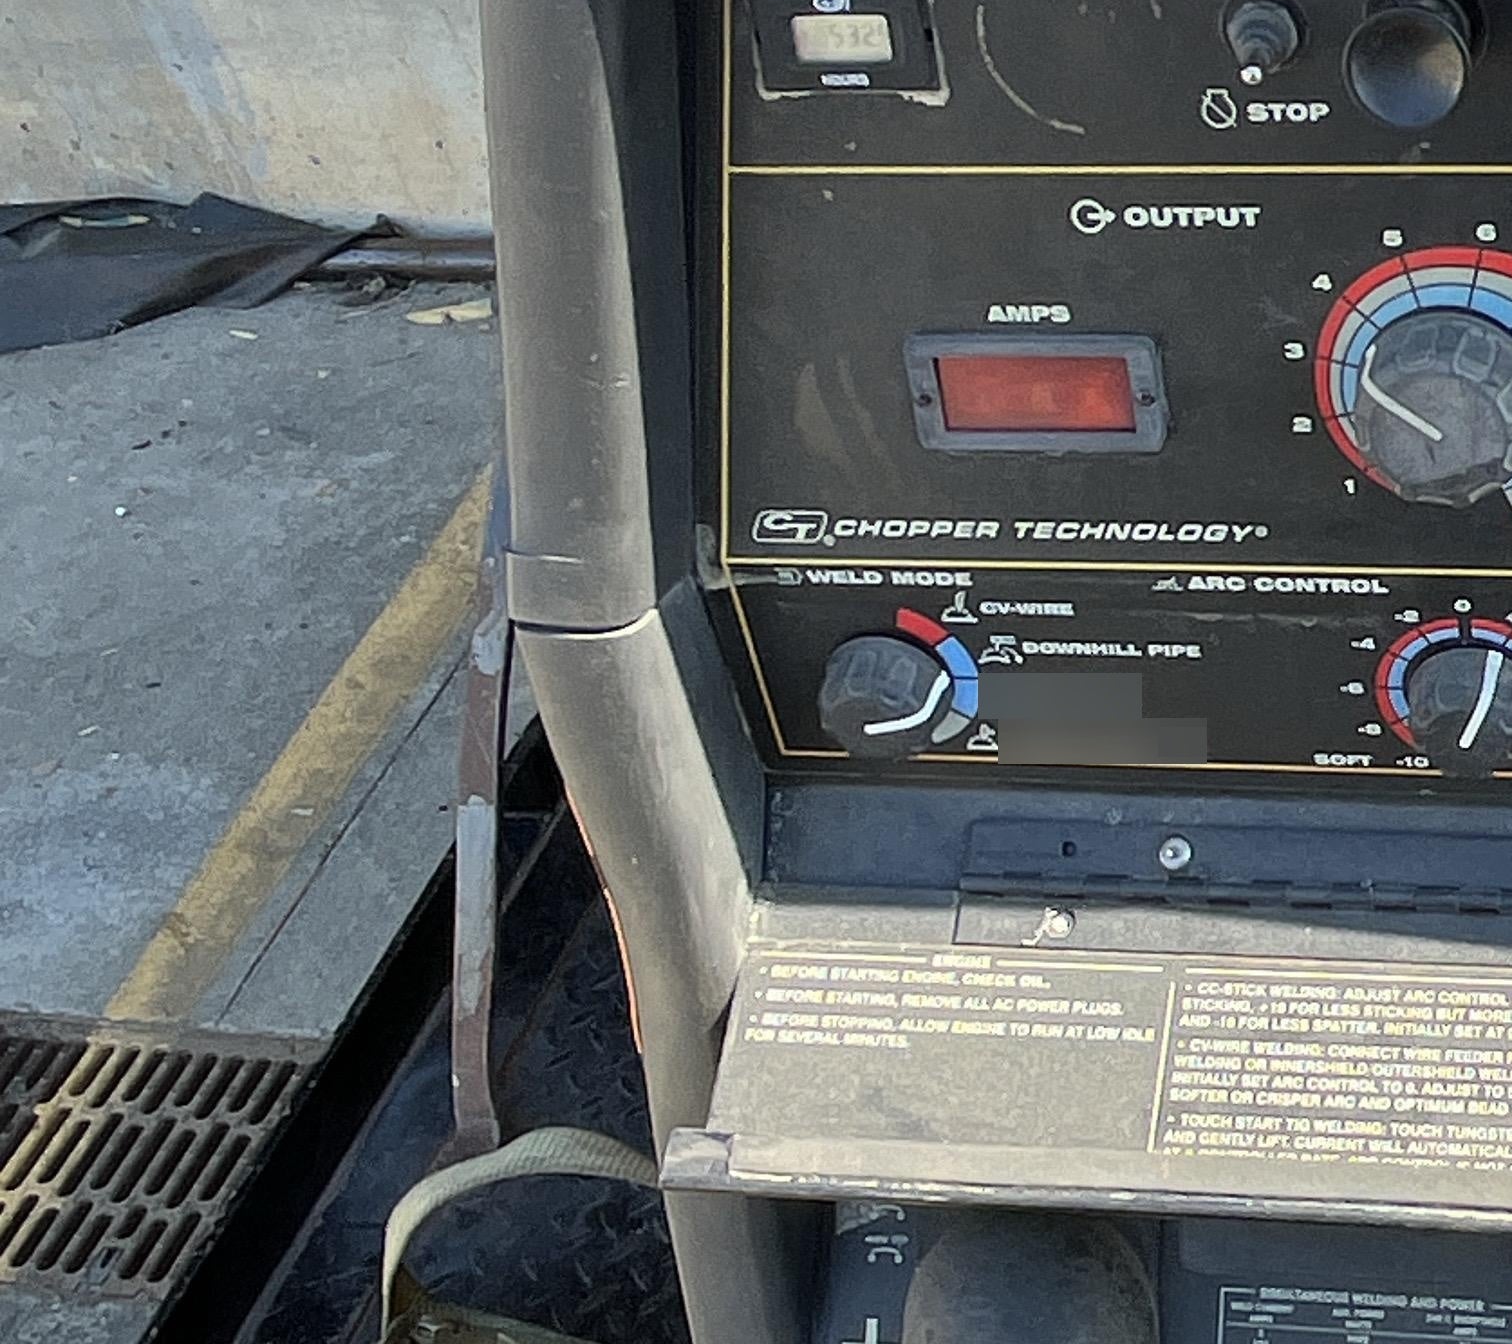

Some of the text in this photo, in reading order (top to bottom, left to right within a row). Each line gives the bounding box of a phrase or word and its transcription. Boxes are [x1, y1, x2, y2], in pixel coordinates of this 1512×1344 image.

[1246, 102, 1330, 122] STOP
[1123, 206, 1261, 227] OUTPUT
[1383, 230, 1403, 247] 5
[1475, 223, 1497, 241] 6
[1312, 274, 1332, 291] 4
[987, 305, 1071, 323] AMPS
[1284, 342, 1304, 359] 3
[1292, 416, 1312, 433] 2
[1343, 479, 1355, 494] 1
[834, 519, 1000, 540] CHOPPER
[805, 569, 973, 586] WELD MODE
[1187, 575, 1390, 595] ARC CONTROL
[979, 601, 1075, 616] CV-WIRE
[1453, 599, 1472, 613] 0
[1022, 641, 1202, 659] DOWNHILL PIPE
[1312, 753, 1374, 768] SOFT
[771, 964, 1015, 987] BEFORE STARTING CHECK
[1197, 981, 1266, 997] CC-STICK
[765, 988, 1069, 1013] BEFORE REMOVE ALL AC POWER
[1363, 1004, 1432, 1019] STICKING
[761, 1012, 1154, 1041] BEFORE ALLOW ENGINE TO RUN AT LOW IDLE
[1383, 1021, 1451, 1037] INITIALLY
[744, 1027, 840, 1045] FOR SEVERAL
[1189, 1038, 1400, 1059] CV-WIRE CONNECT
[1174, 1055, 1241, 1070] WELDING
[1171, 1071, 1378, 1093] INITIALLY CONTROL
[1256, 1091, 1464, 1113] CRISPER OPTIMUM
[1293, 1135, 1365, 1152] CURRENT
